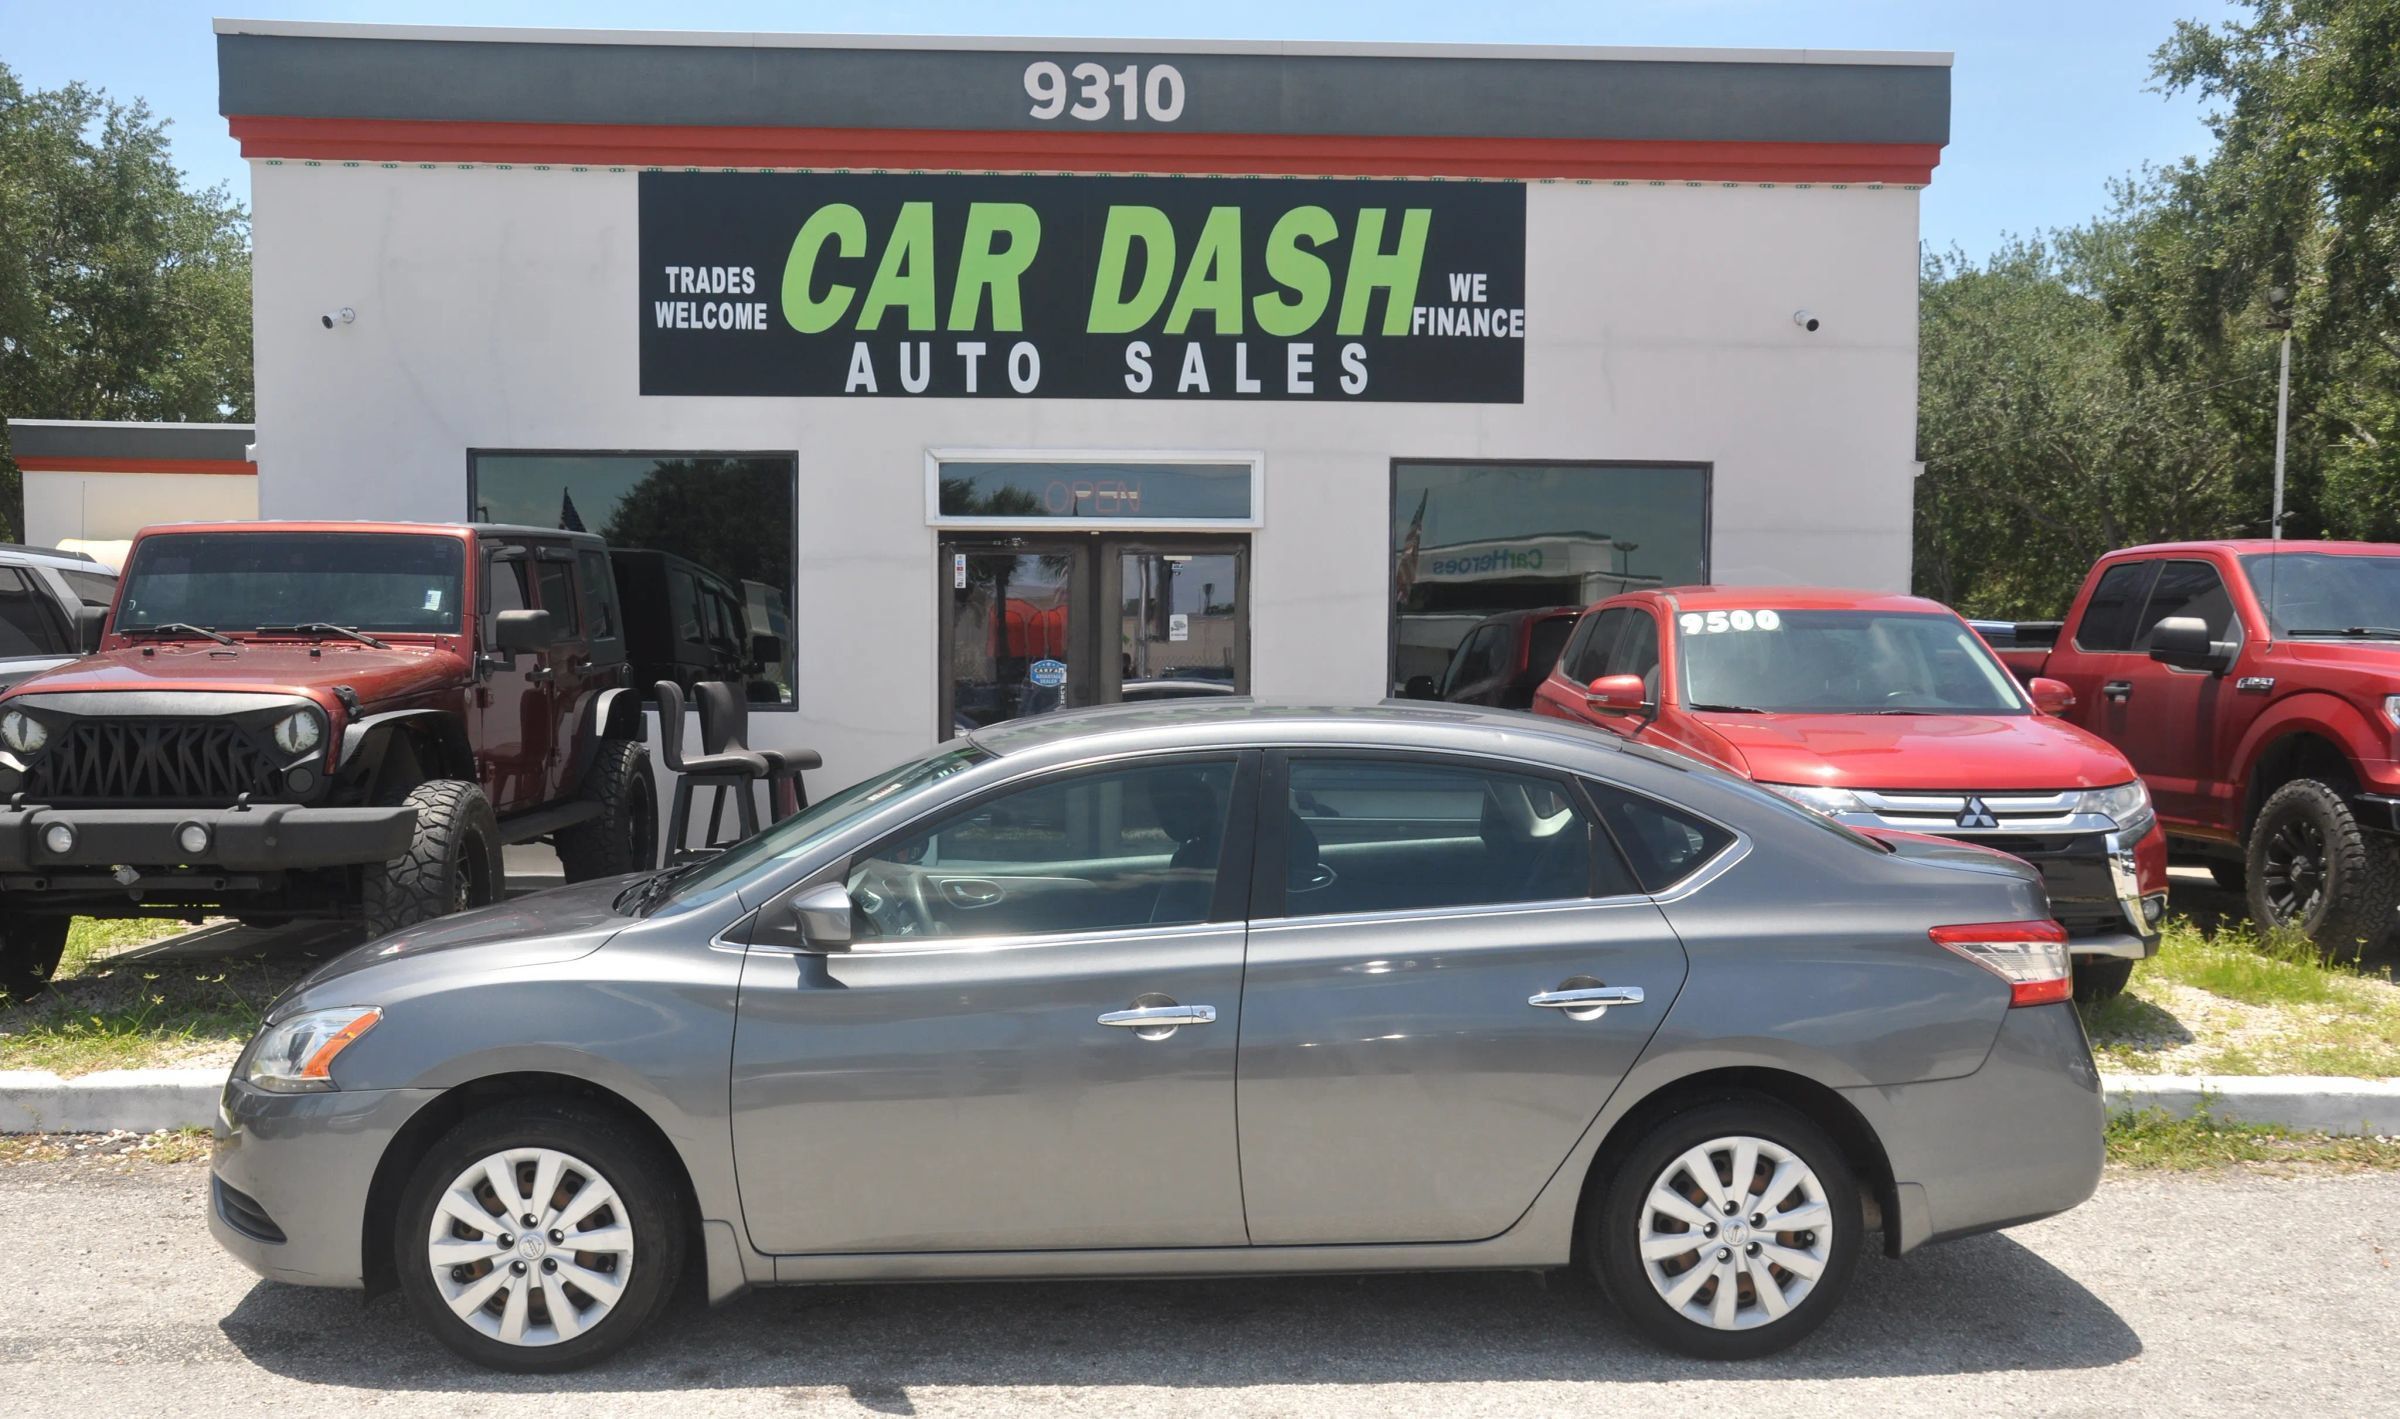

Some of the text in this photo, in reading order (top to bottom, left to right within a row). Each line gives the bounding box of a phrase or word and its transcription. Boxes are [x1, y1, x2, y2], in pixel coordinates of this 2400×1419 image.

[1023, 61, 1186, 122] 9310
[665, 266, 756, 295] TRADES
[782, 201, 1431, 336] CAR DASH
[1448, 272, 1488, 303] WE
[655, 301, 768, 331] WELCOME
[1412, 306, 1524, 338] FINANCE
[845, 341, 1369, 395] AUTO SALES
[1045, 480, 1142, 513] OPEN
[1679, 609, 1780, 635] 9500
